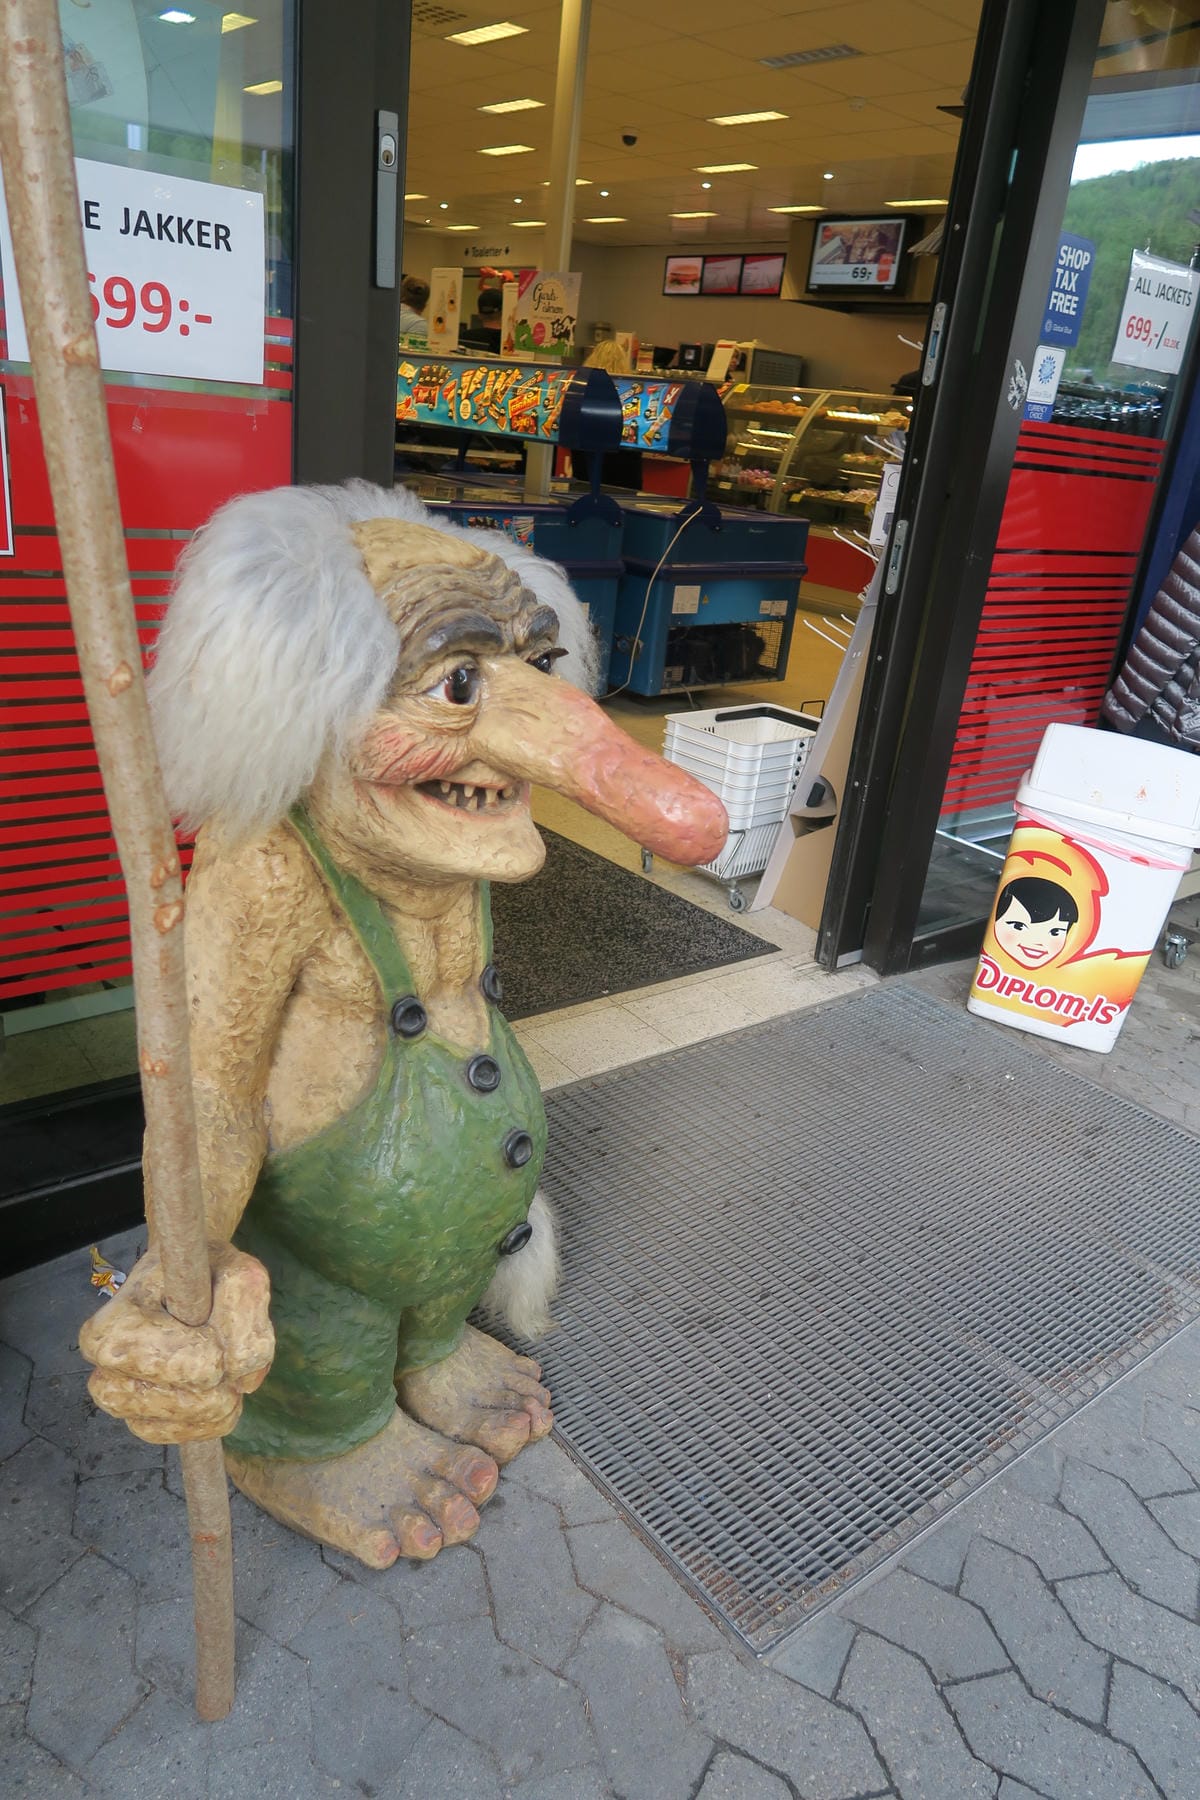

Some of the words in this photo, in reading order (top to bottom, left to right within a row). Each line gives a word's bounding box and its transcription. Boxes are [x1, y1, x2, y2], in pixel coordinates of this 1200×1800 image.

[81, 199, 101, 231] E
[119, 206, 232, 252] JAKKER
[1057, 244, 1091, 272] SHOP
[1054, 267, 1079, 293] TAX
[1134, 276, 1152, 296] ALL
[1155, 282, 1192, 308] JACKETS
[1048, 289, 1079, 317] FREE
